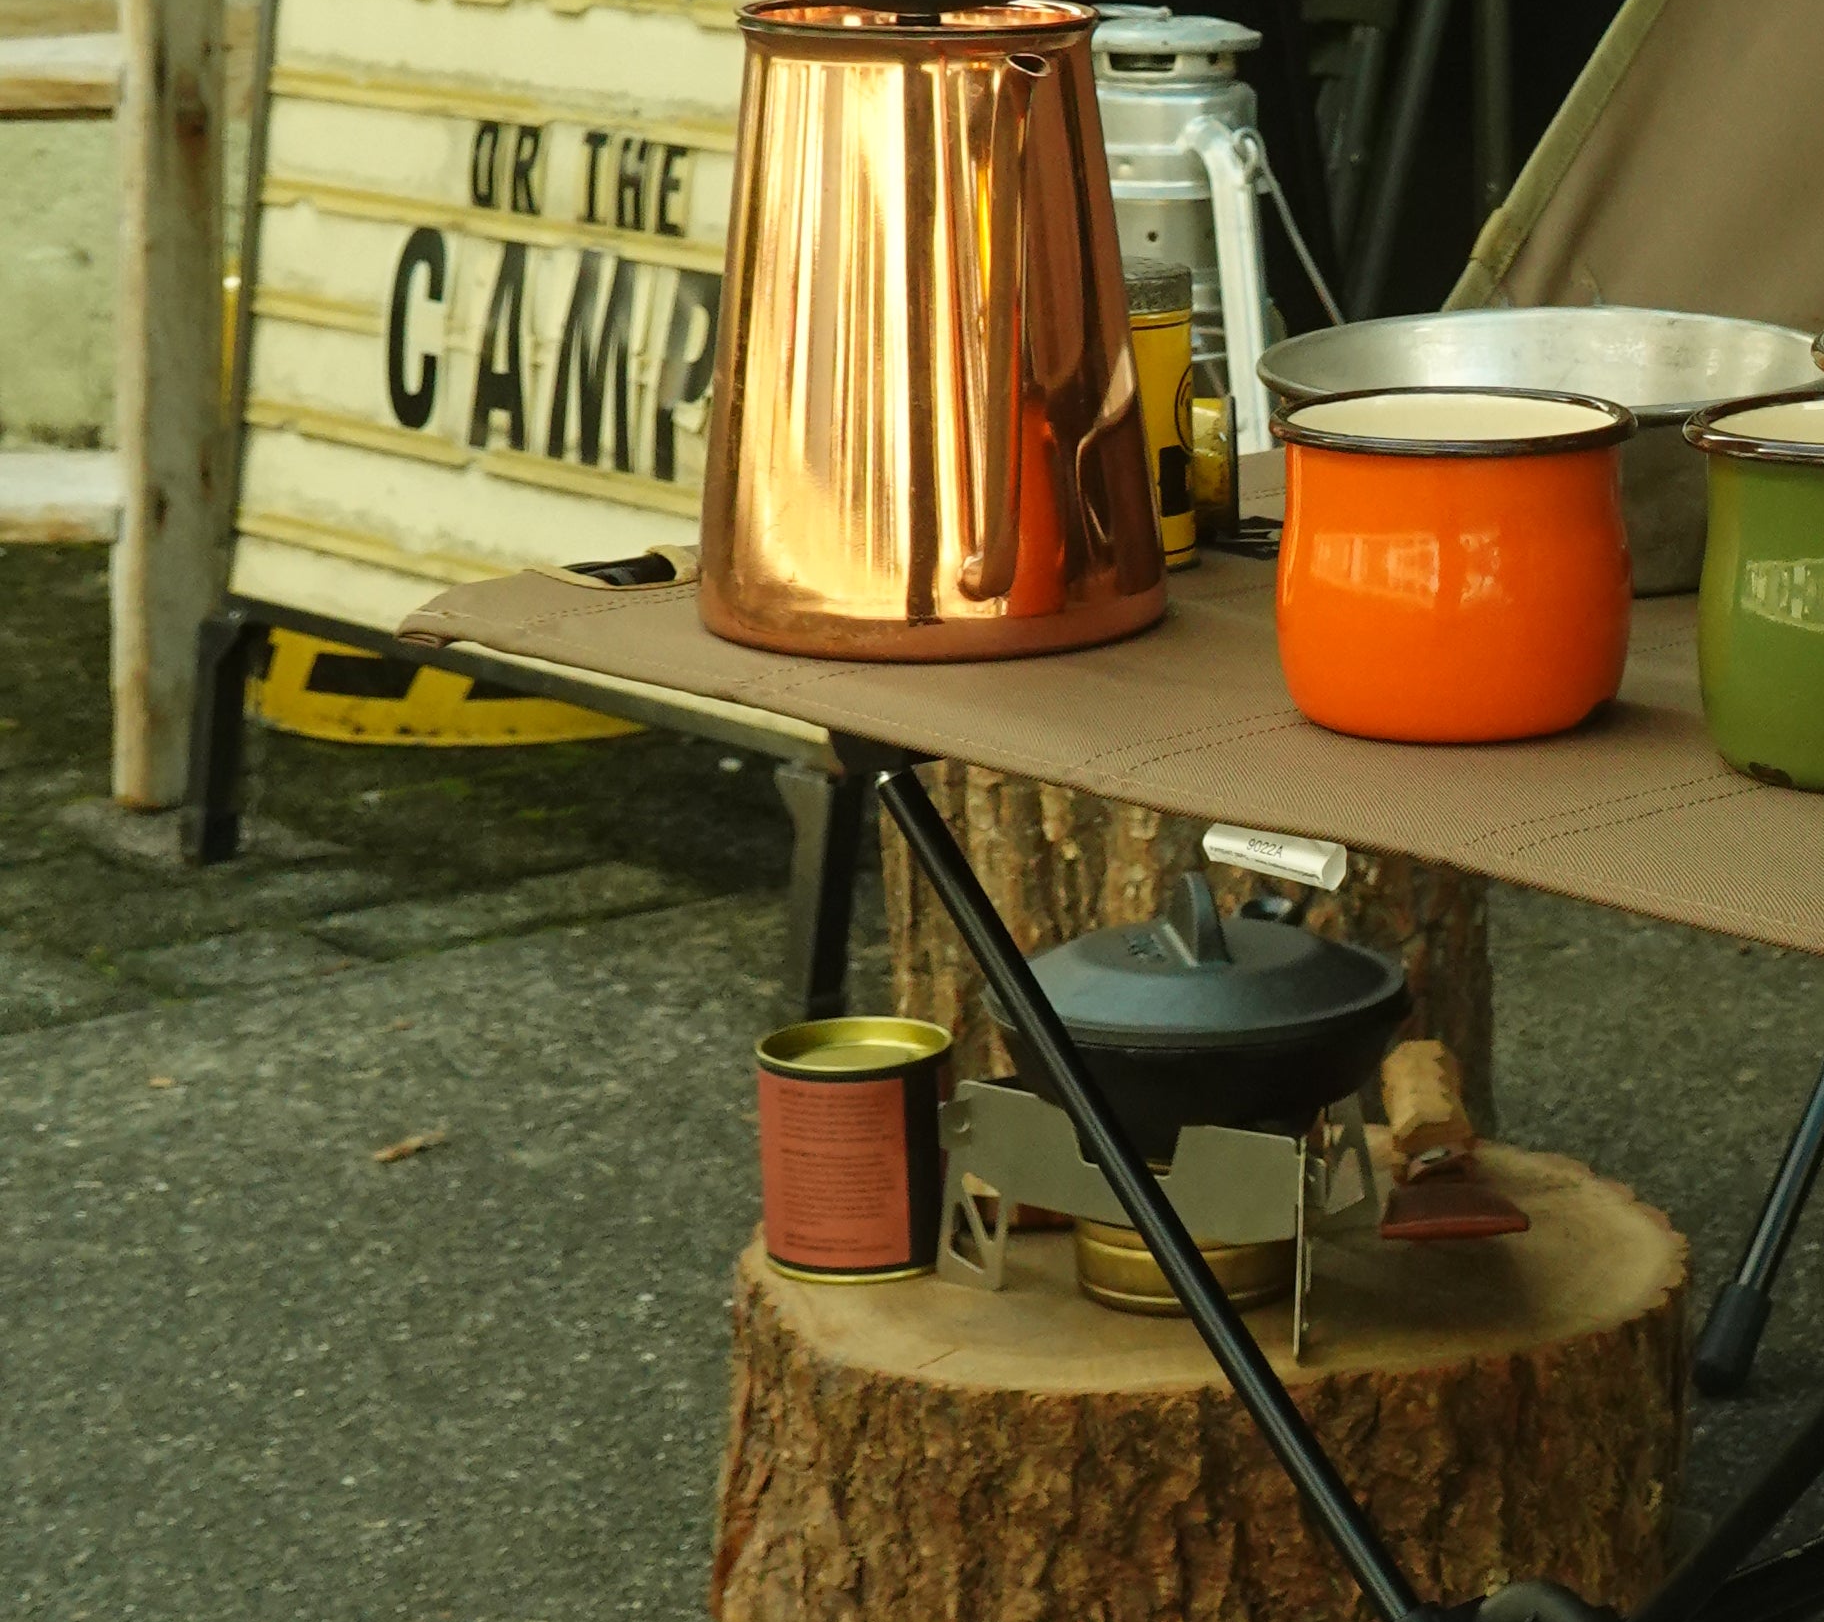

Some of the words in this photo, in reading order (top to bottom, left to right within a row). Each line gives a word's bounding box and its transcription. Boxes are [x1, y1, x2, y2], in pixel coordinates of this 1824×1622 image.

[471, 120, 542, 217] OR
[577, 131, 689, 237] THE
[387, 225, 725, 482] CAMP
[1246, 837, 1284, 859] 9022A
